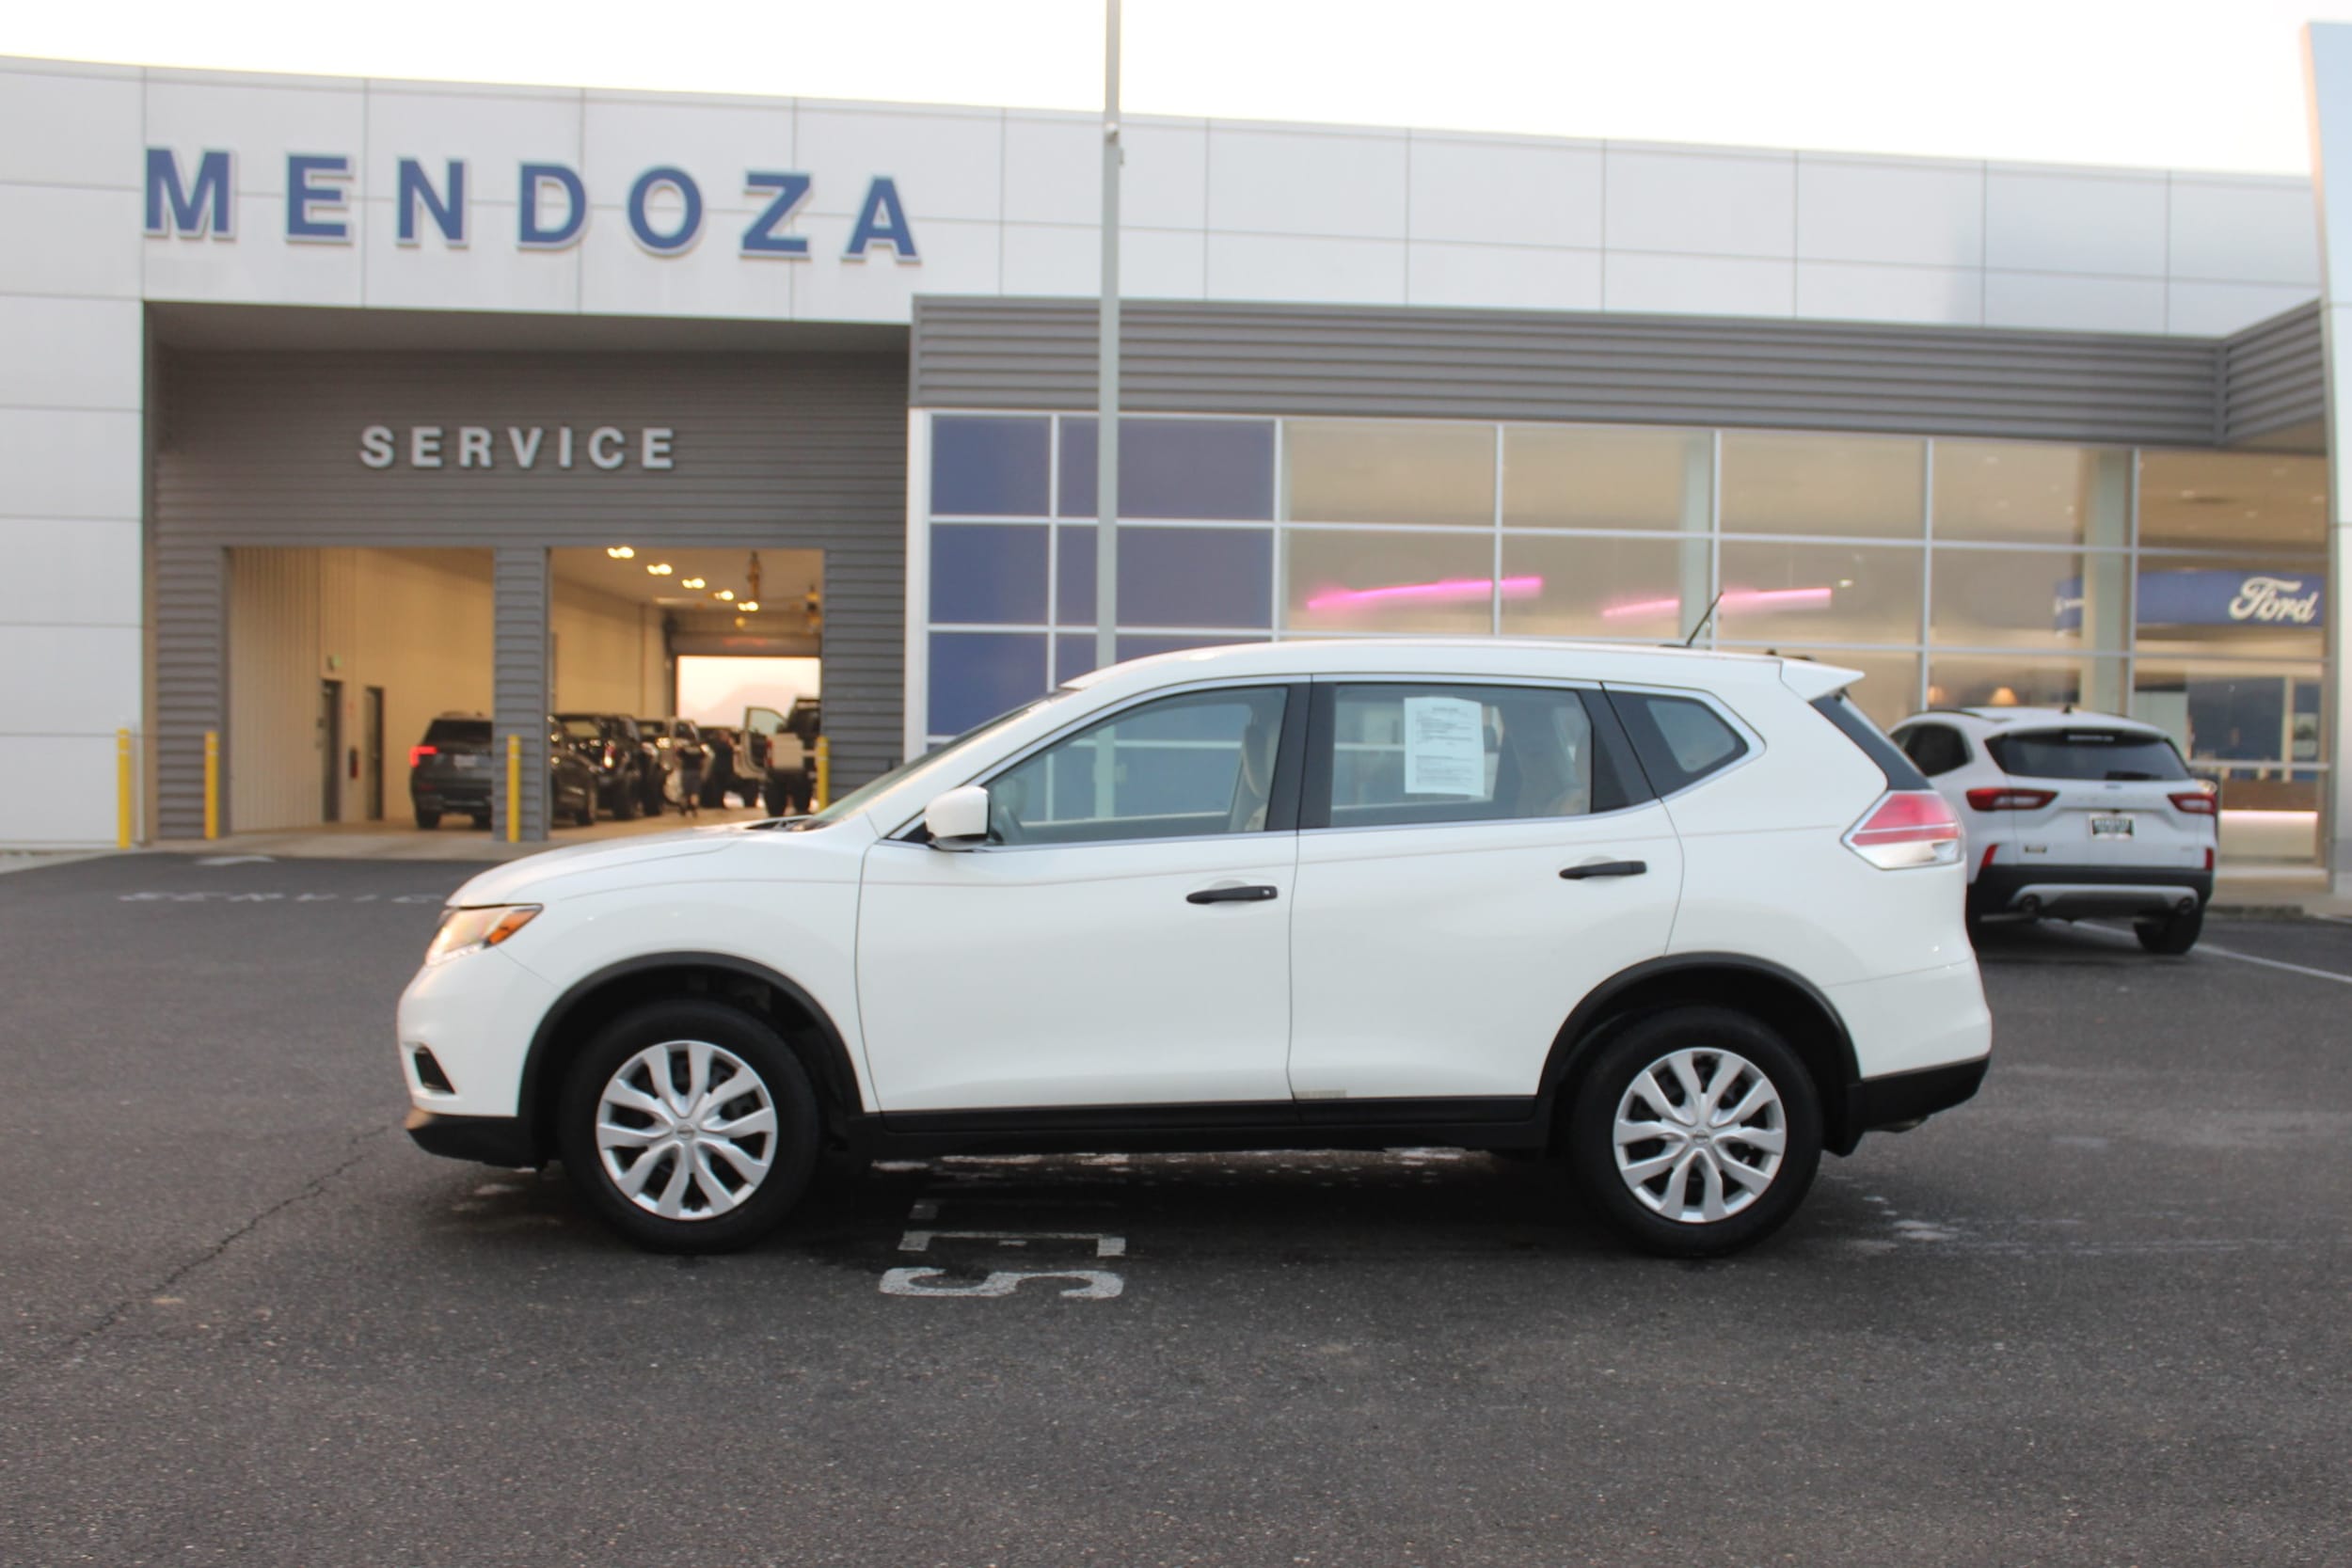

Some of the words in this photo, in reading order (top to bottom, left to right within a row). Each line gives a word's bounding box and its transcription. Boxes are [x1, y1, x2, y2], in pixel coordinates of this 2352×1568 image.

[145, 148, 920, 263] MENDOZA
[359, 426, 674, 469] SERVICE
[2228, 576, 2319, 623] Ford
